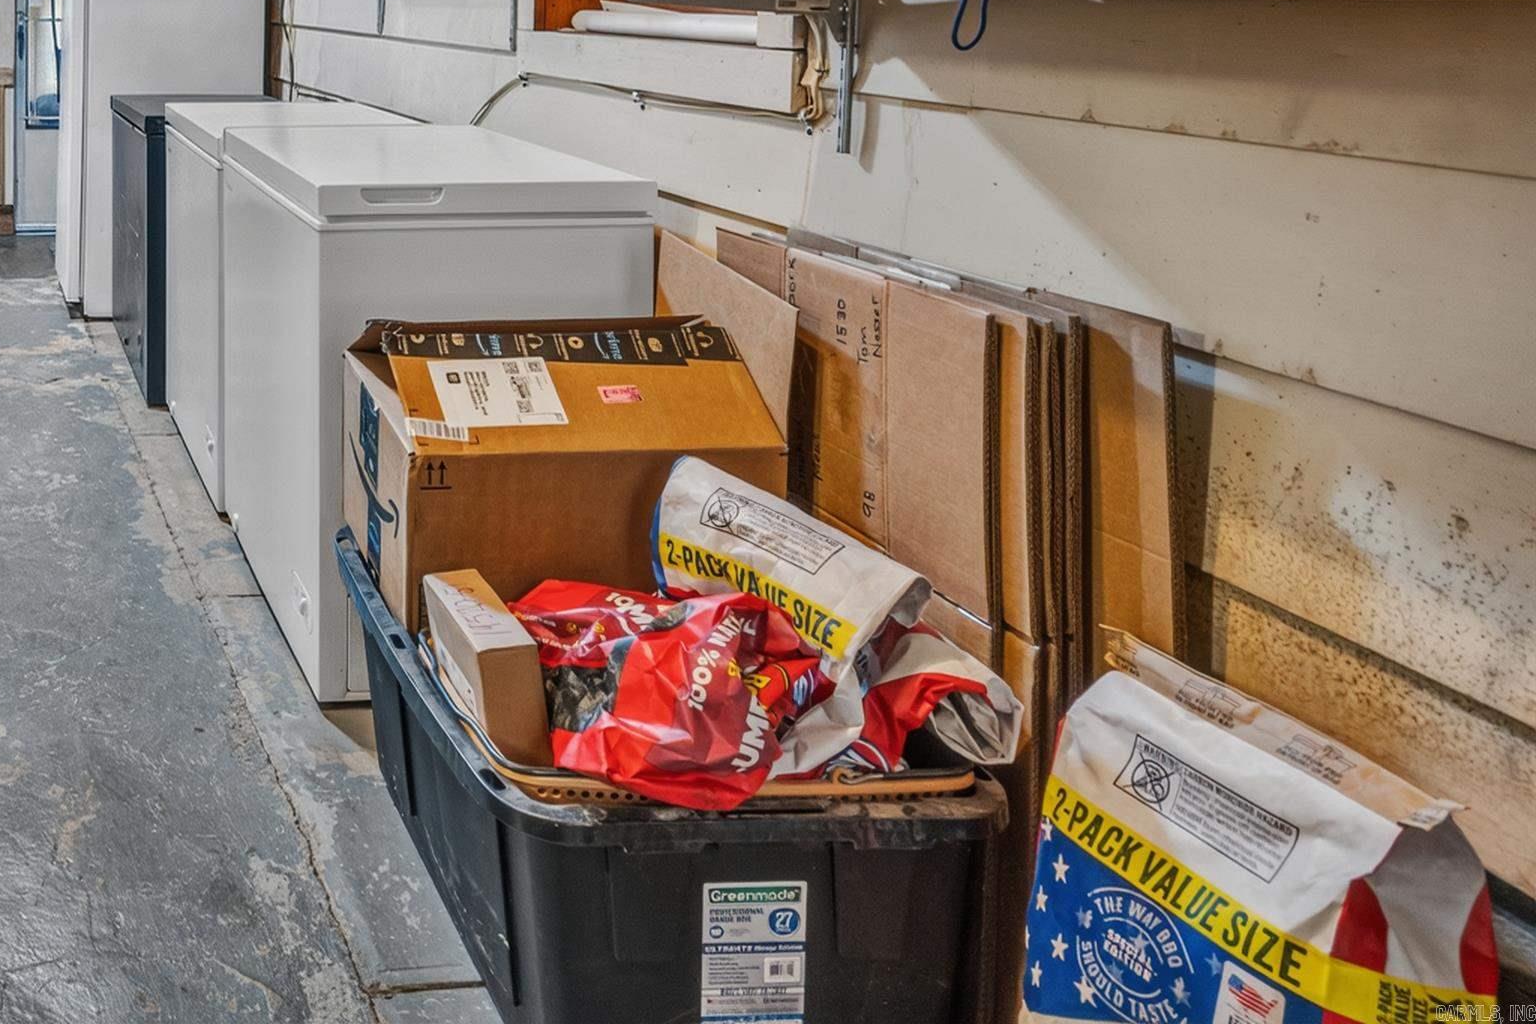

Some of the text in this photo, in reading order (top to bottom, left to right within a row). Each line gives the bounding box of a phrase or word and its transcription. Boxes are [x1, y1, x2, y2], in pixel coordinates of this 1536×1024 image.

[857, 327, 868, 365] Tom
[666, 540, 732, 581] 2-PACK
[793, 599, 841, 650] SIZE
[688, 648, 721, 712] 100%
[1052, 787, 1145, 872] 2-PACK
[1143, 851, 1230, 933] VALUE
[1221, 909, 1308, 988] SIZE
[775, 911, 793, 929] 27
[1094, 896, 1124, 915] THE
[1129, 900, 1163, 936] WAY
[1081, 940, 1178, 1023] SHOULD TASTE
[1102, 940, 1155, 983] EDITION
